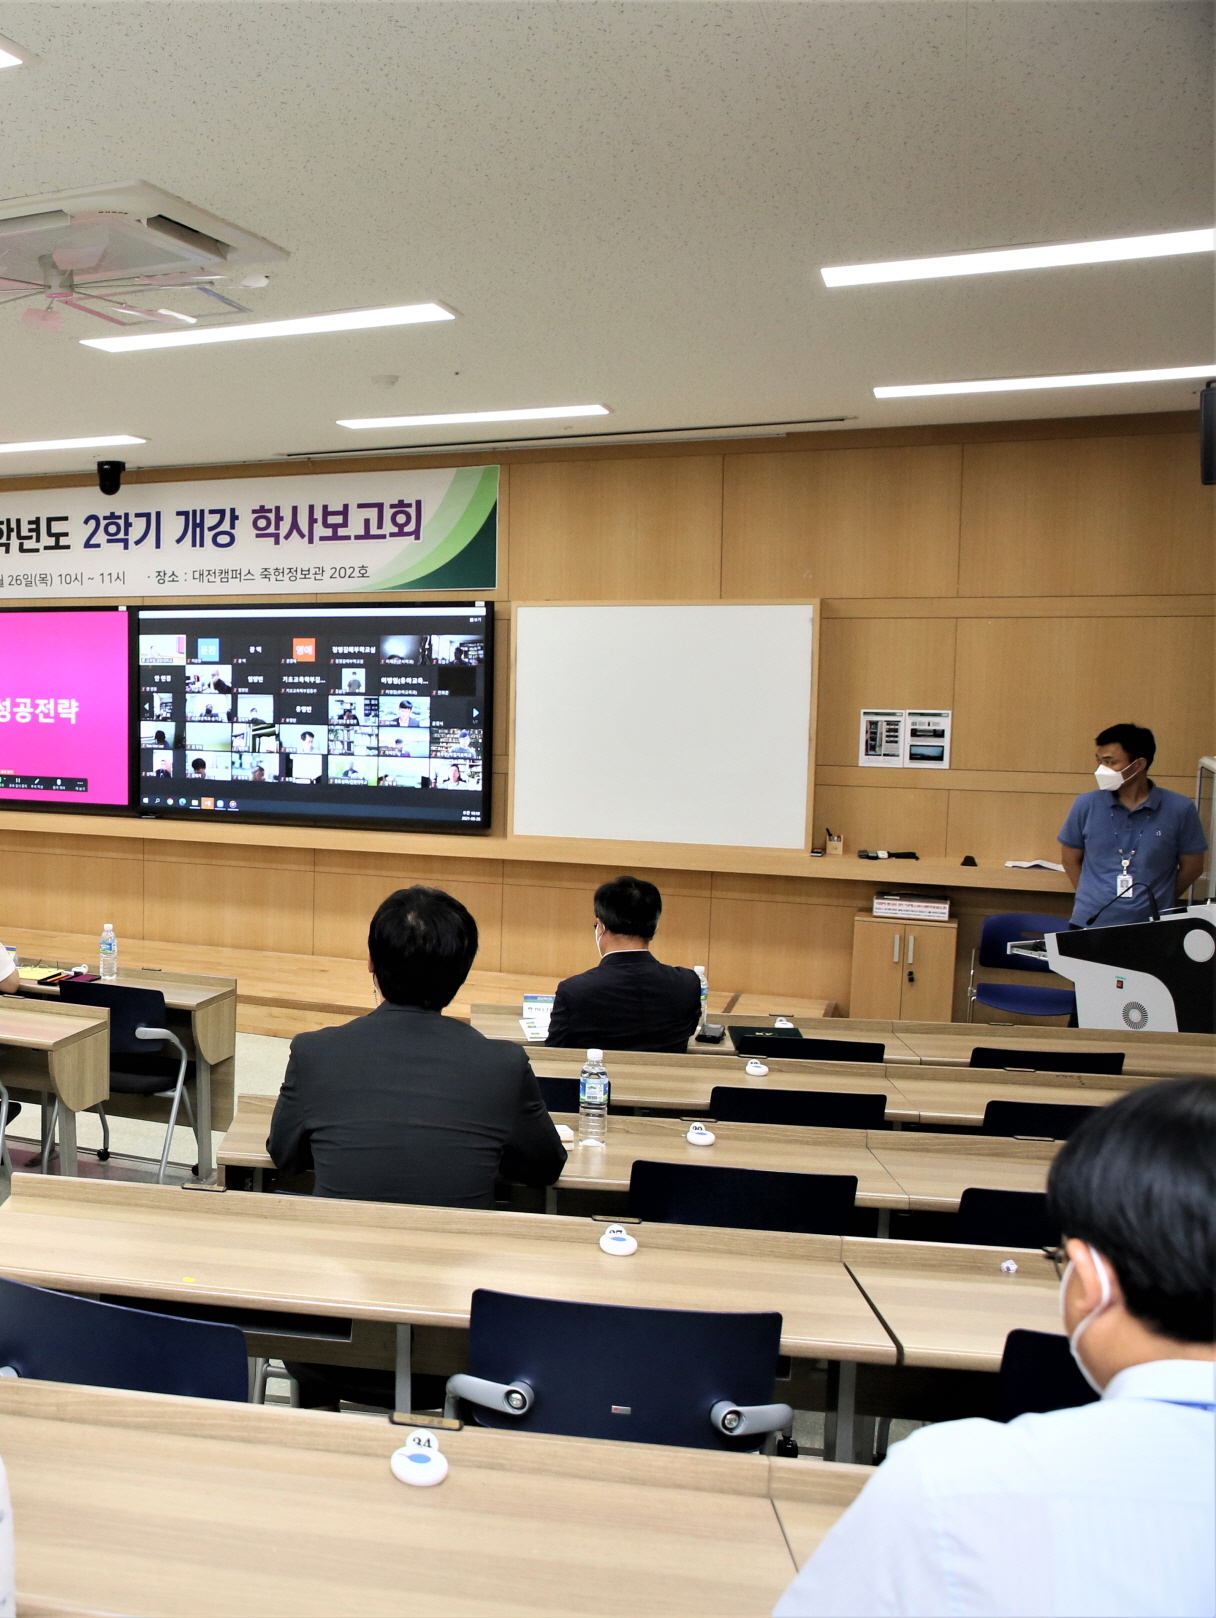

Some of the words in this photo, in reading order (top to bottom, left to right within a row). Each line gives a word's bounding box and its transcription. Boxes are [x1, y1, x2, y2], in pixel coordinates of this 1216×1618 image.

[82, 510, 162, 551] 2학기
[175, 507, 240, 549] 개강
[251, 499, 423, 546] 학사보고회
[7, 572, 53, 587] 26일(목)
[58, 571, 83, 586] 10시
[99, 571, 126, 585] 11시
[155, 569, 180, 584] 장소
[192, 568, 256, 584] 대전캠퍼스
[259, 565, 326, 583] 죽헌정보관
[329, 564, 370, 579] 202호
